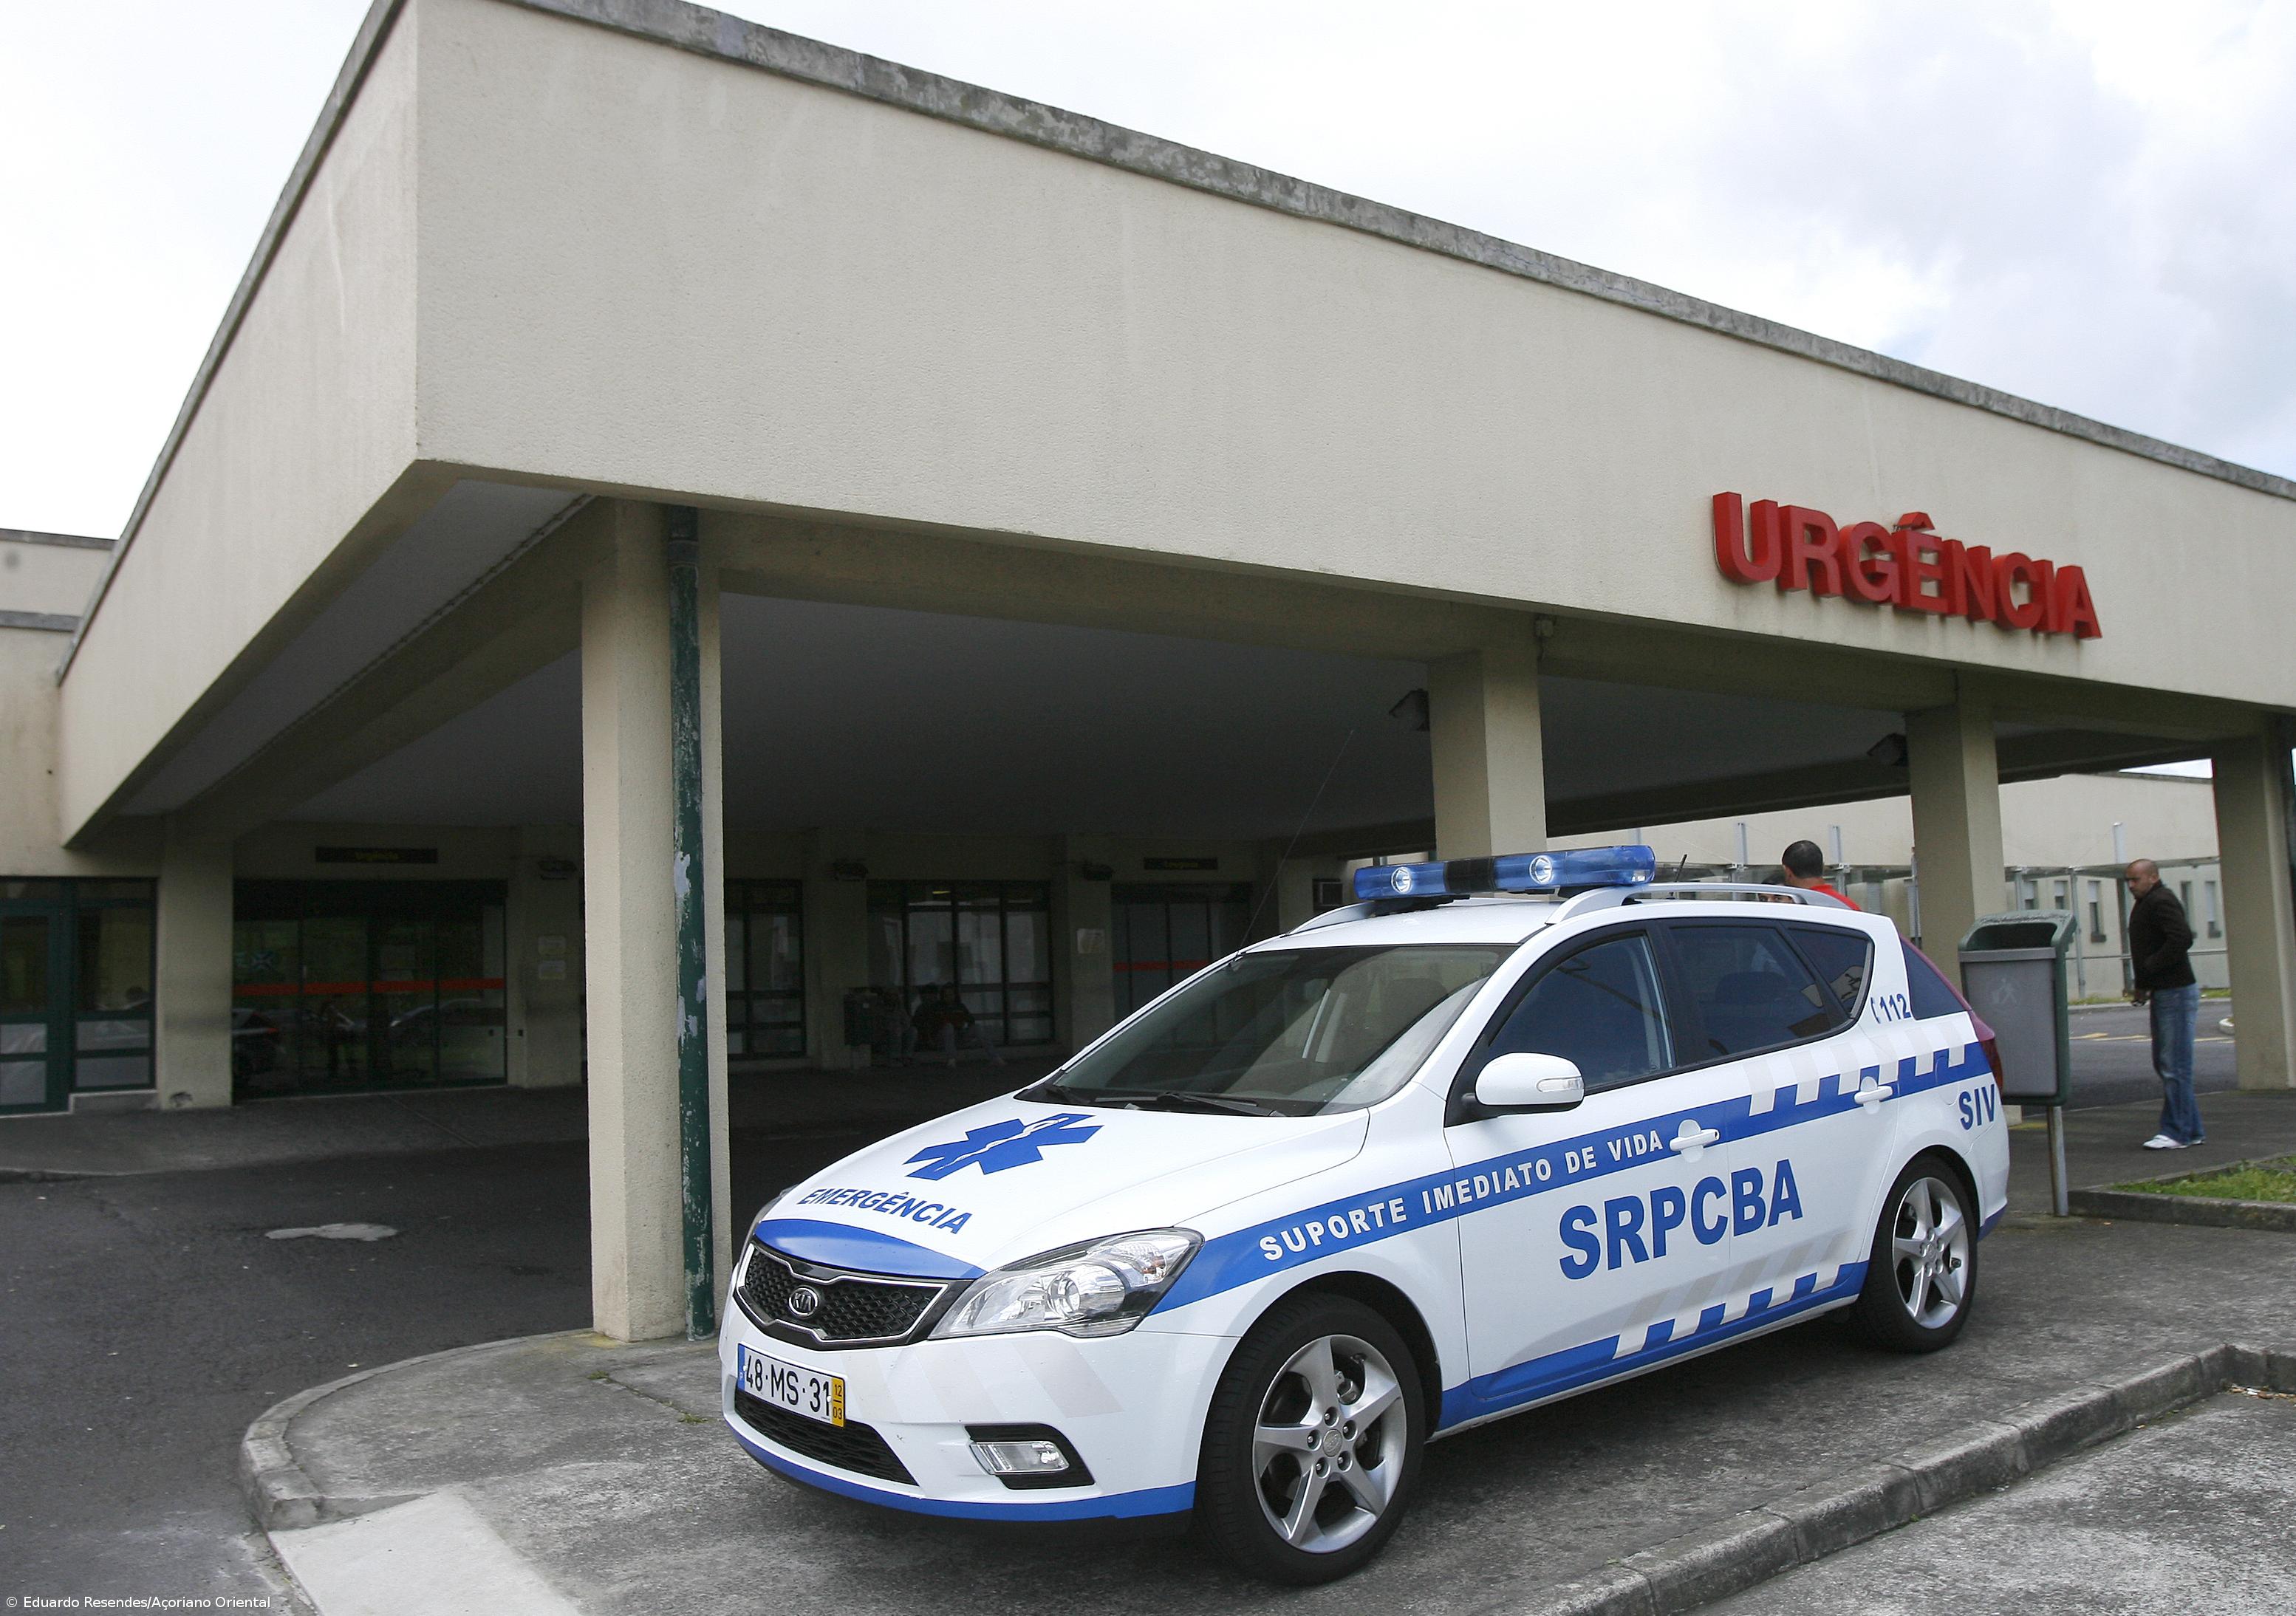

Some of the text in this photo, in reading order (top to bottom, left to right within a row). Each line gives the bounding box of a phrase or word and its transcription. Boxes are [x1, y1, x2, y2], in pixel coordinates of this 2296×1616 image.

[1712, 491, 2102, 640] URGÊNCIA
[1879, 993, 1912, 1022] 112
[1958, 1083, 1995, 1131] SIV
[796, 1188, 972, 1234] EMERGÊNCIA
[1259, 1130, 1664, 1261] SUPORTE IMEDIATO DE VIDA
[1559, 1159, 1803, 1280] SRPCBA
[793, 1293, 812, 1312] KIA
[833, 1407, 843, 1420] 03
[834, 1384, 843, 1397] 12
